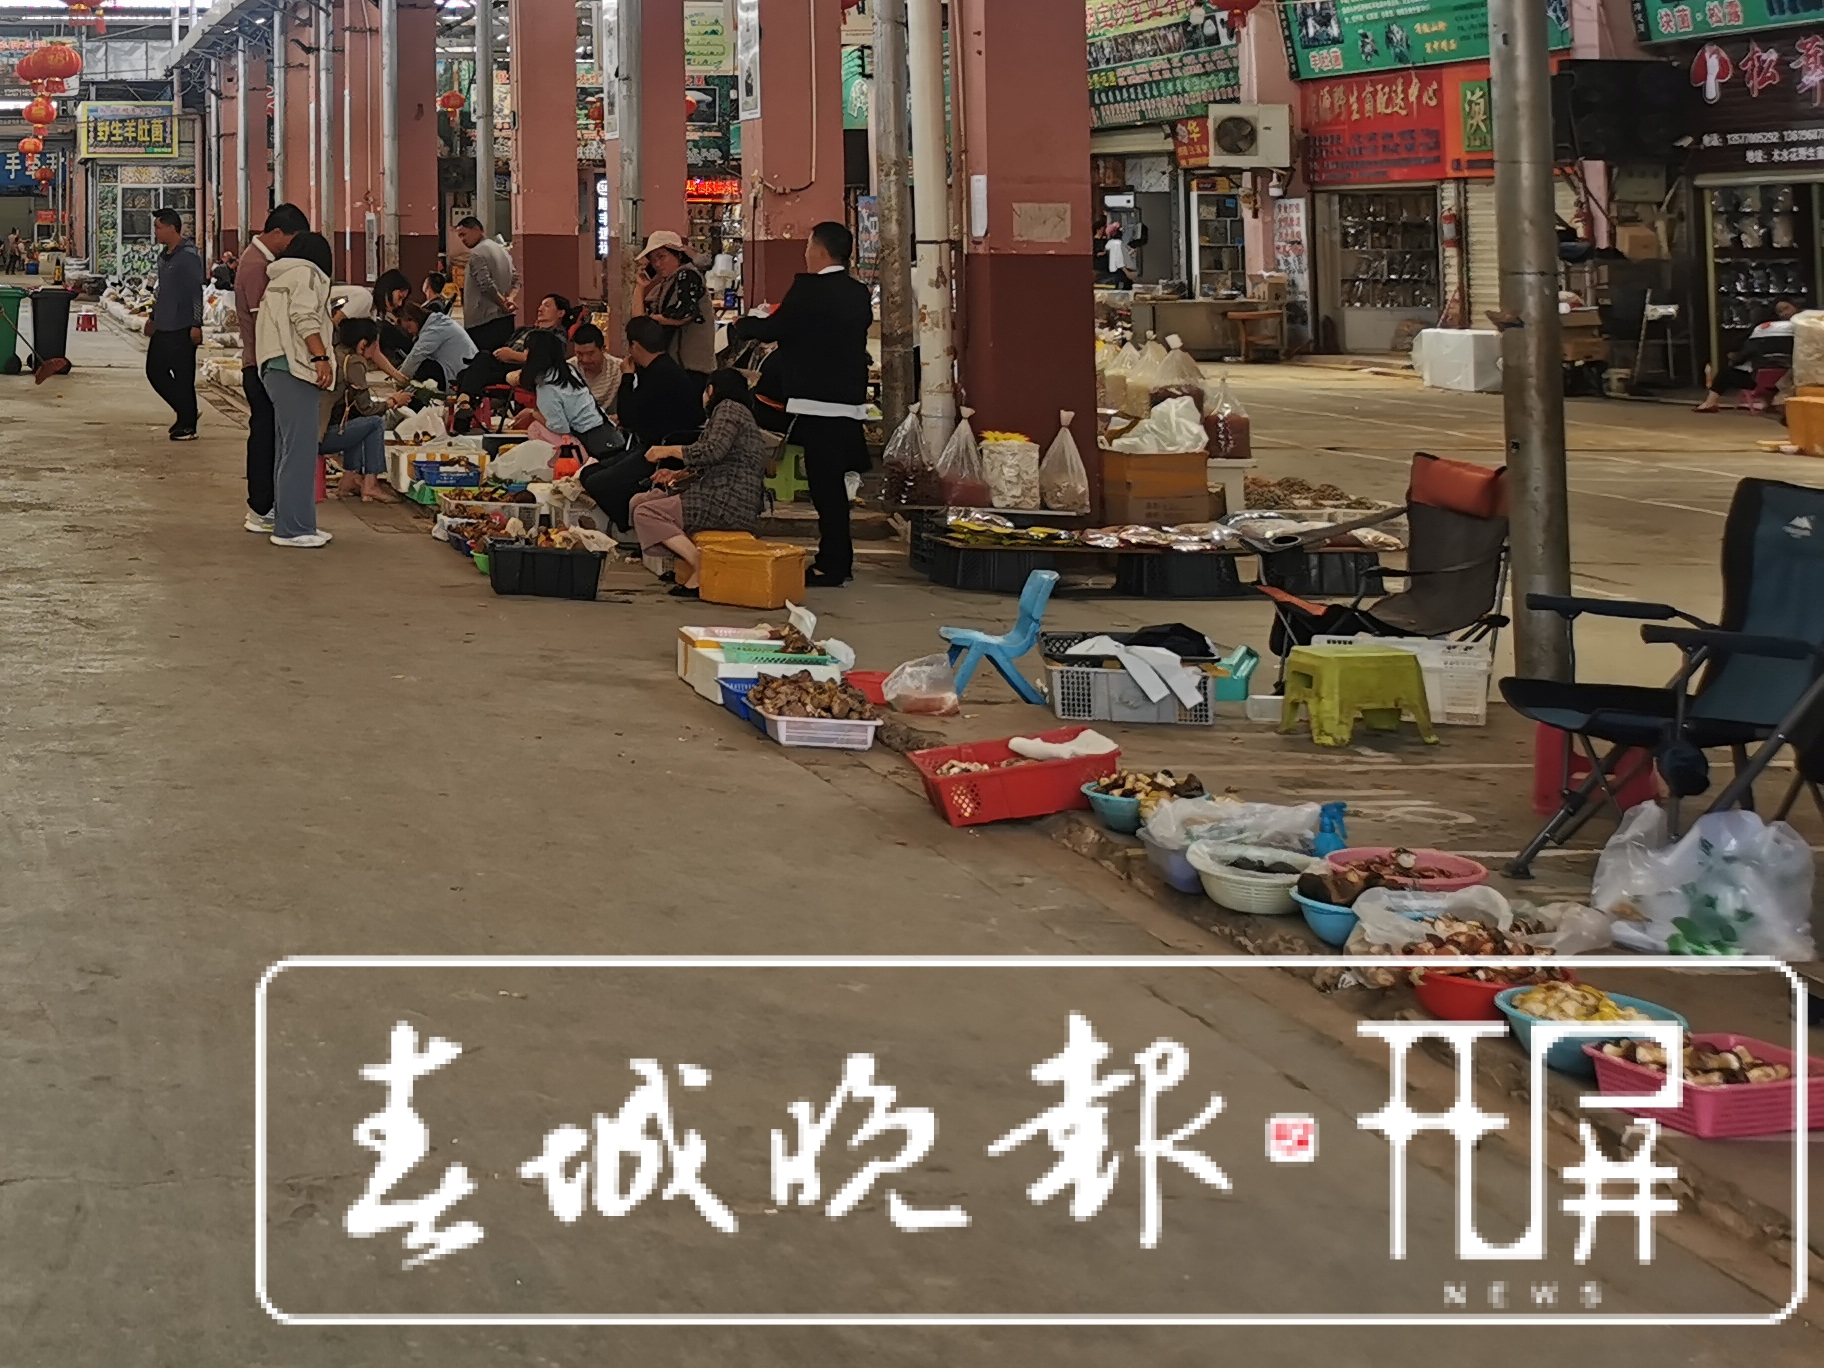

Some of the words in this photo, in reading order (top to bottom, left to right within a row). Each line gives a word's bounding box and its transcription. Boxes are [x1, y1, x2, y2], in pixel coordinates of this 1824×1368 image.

[97, 118, 164, 143] 野生羊肚菌
